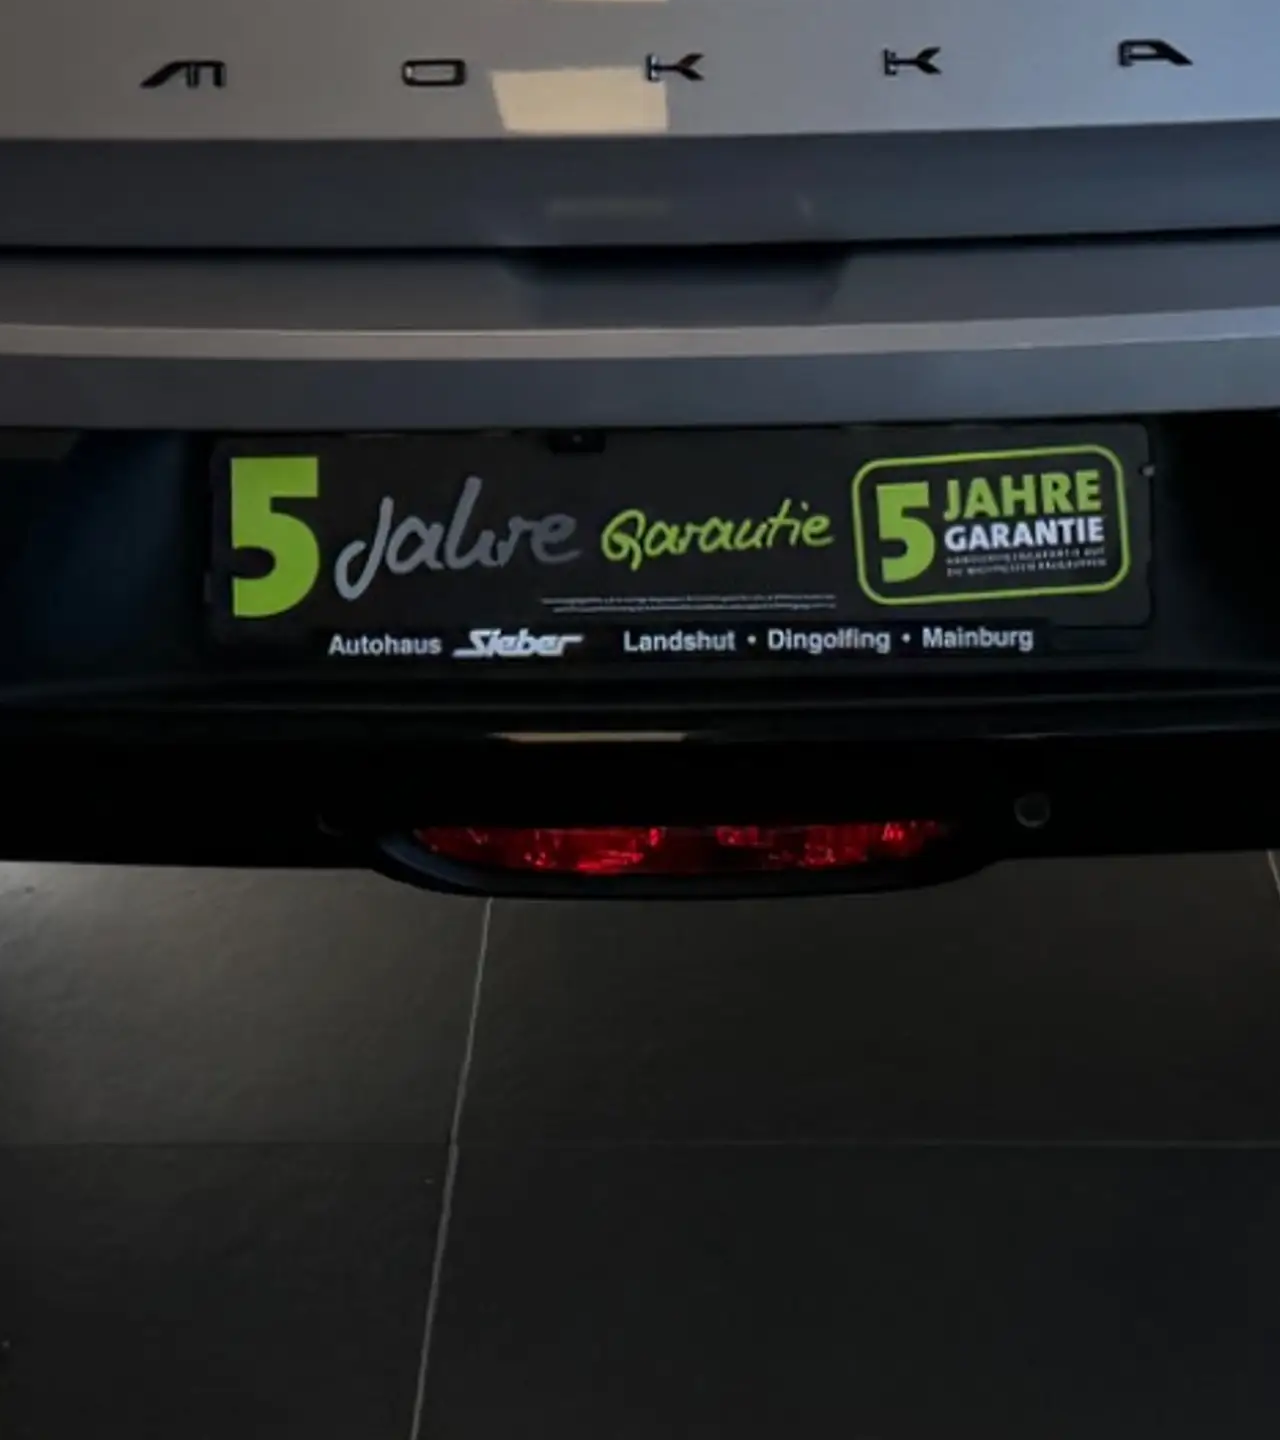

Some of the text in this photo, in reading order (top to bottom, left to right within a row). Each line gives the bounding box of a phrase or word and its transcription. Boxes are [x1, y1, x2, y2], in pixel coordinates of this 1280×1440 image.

[231, 457, 836, 618] 5 Jahre Garantie
[876, 469, 1102, 583] 5 JAHRE
[944, 516, 1106, 552] GARANTIE
[328, 626, 1034, 658] Autohaus Sieber Landshut Dingolfing Mainburg
